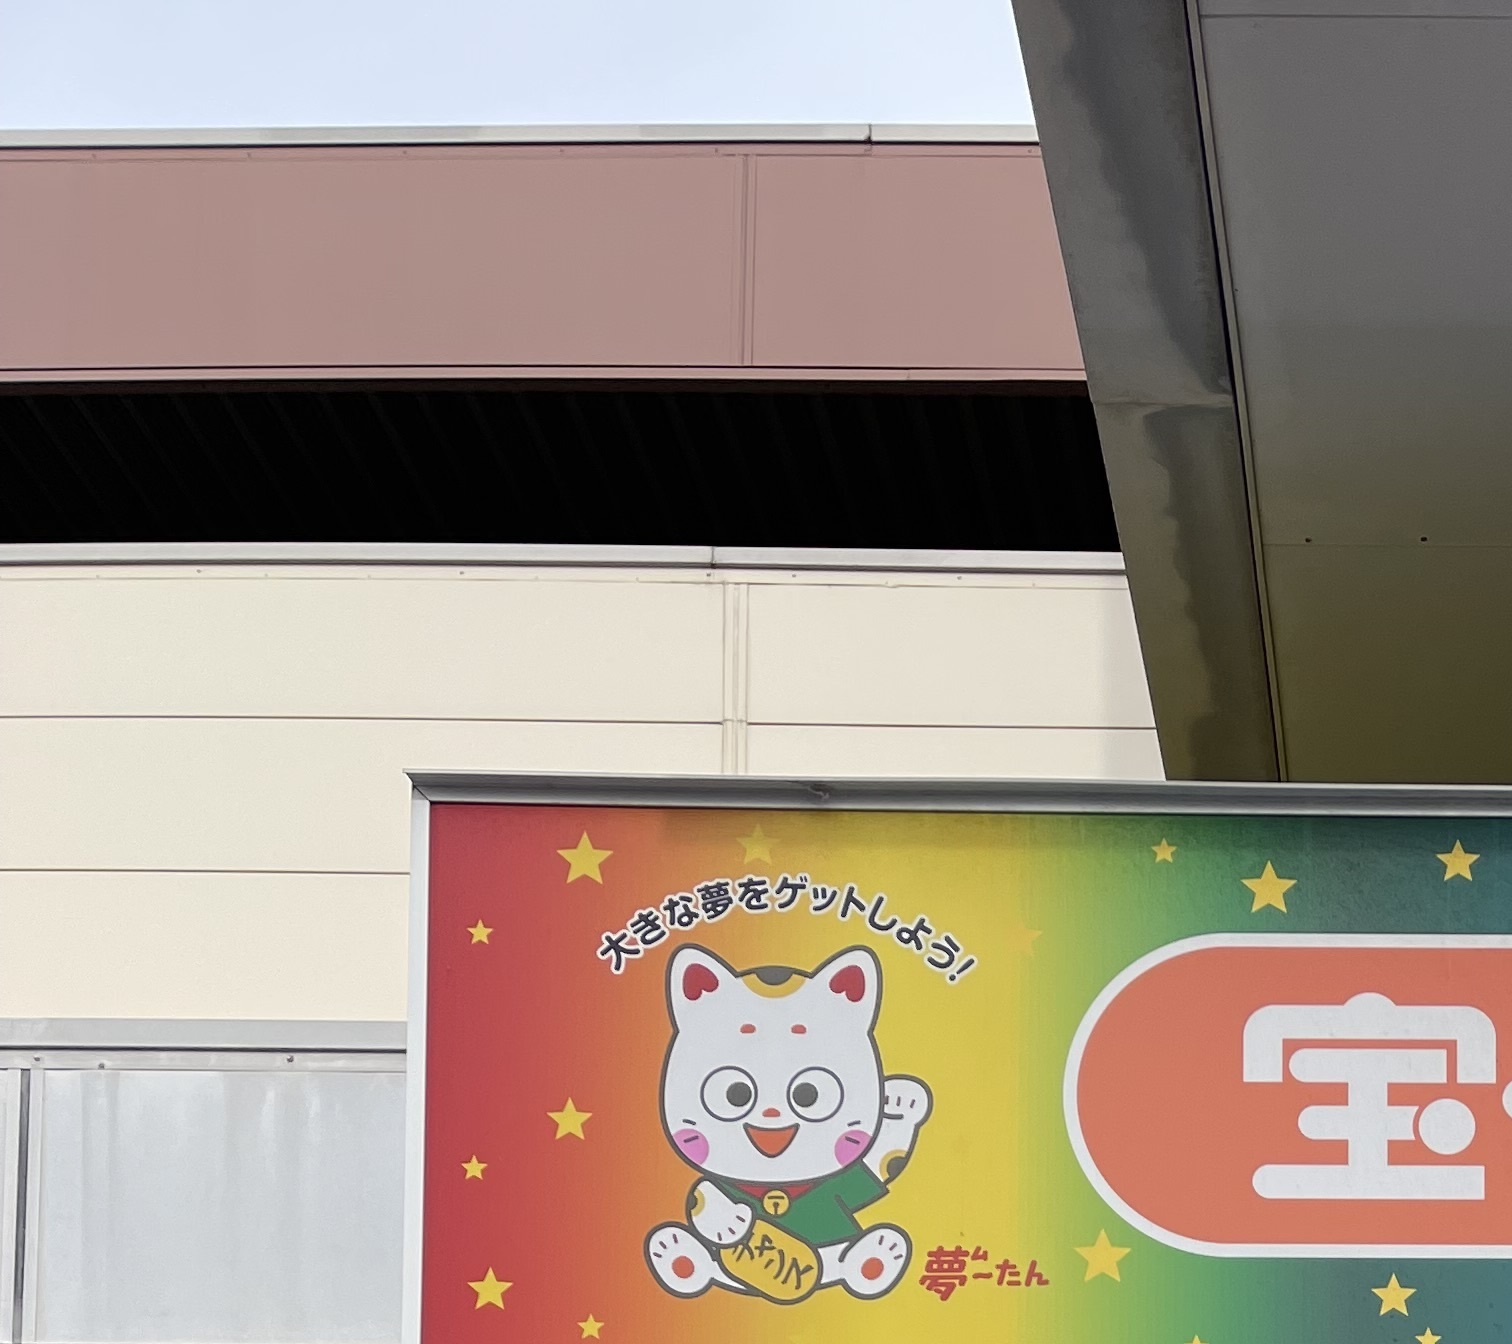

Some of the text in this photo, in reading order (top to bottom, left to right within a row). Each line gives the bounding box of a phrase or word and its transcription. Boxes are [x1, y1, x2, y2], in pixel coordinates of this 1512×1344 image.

[600, 875, 977, 984] 大きな夢をゲットしよう!
